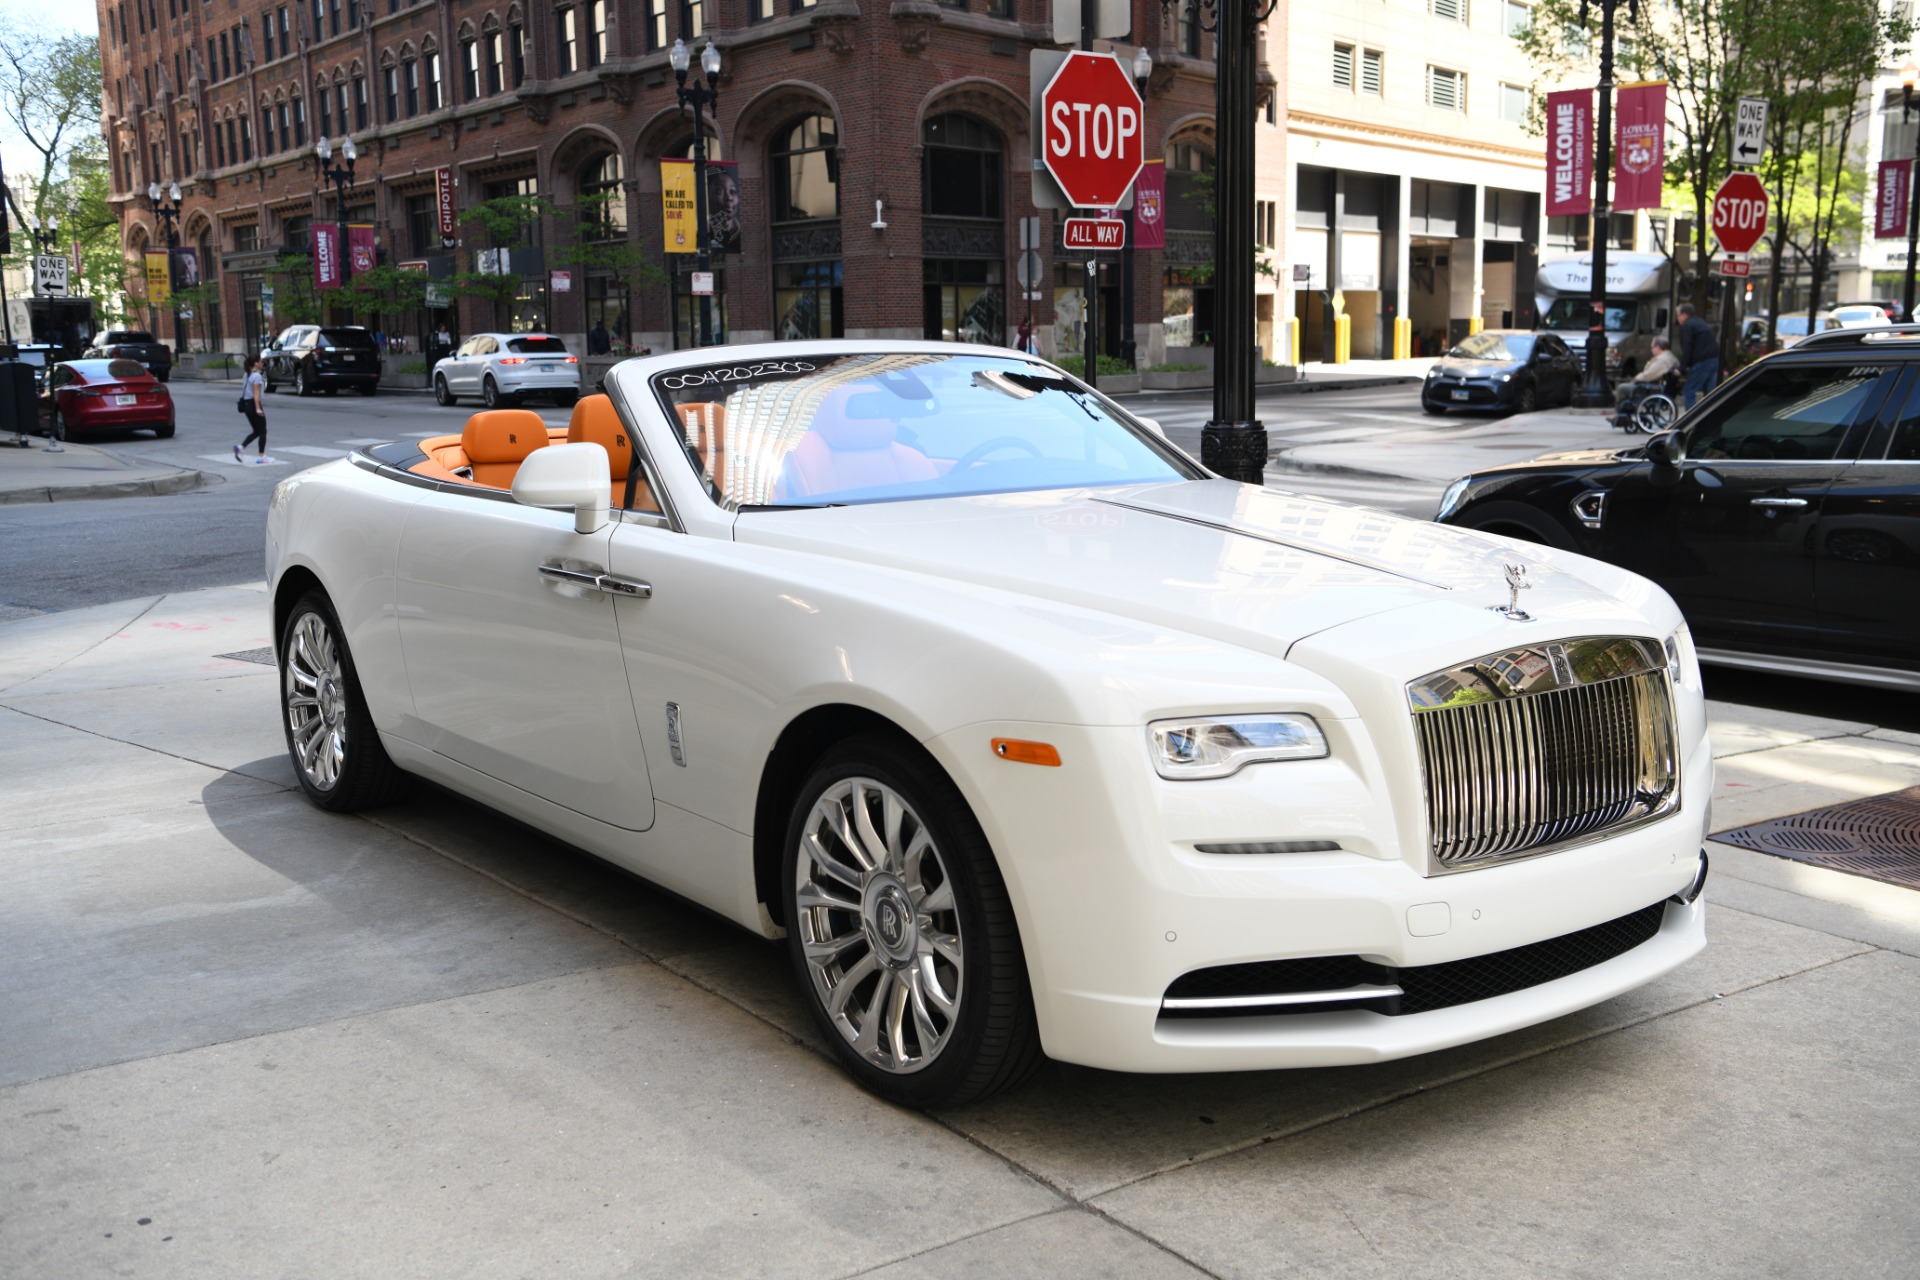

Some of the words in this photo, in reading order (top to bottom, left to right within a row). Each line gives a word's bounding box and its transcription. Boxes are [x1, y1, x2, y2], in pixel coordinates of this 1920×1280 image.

[1740, 104, 1764, 121] ONE
[1051, 100, 1137, 159] STOP
[1576, 108, 1585, 140] CAMPUS
[1622, 124, 1659, 135] LOYOLA
[1738, 122, 1762, 139] WAY
[1555, 103, 1573, 203] WELCOME
[1576, 141, 1584, 168] TOWER
[1575, 170, 1583, 196] WATER
[440, 172, 452, 232] CHIPOTLE
[665, 190, 674, 198] WE
[675, 190, 686, 199] ARE
[1881, 168, 1897, 231] WELCOME
[665, 200, 685, 209] CALLED
[686, 201, 694, 209] TO
[666, 211, 683, 219] SOLVE
[1715, 197, 1765, 230] STOP
[1070, 225, 1092, 242] ALL
[1097, 226, 1119, 243] WAY
[40, 258, 64, 269] ONE
[317, 231, 330, 283] WELCOME
[40, 269, 64, 280] WAY
[1723, 262, 1734, 273] ALL
[1736, 263, 1748, 274] WAY
[1566, 274, 1588, 283] The
